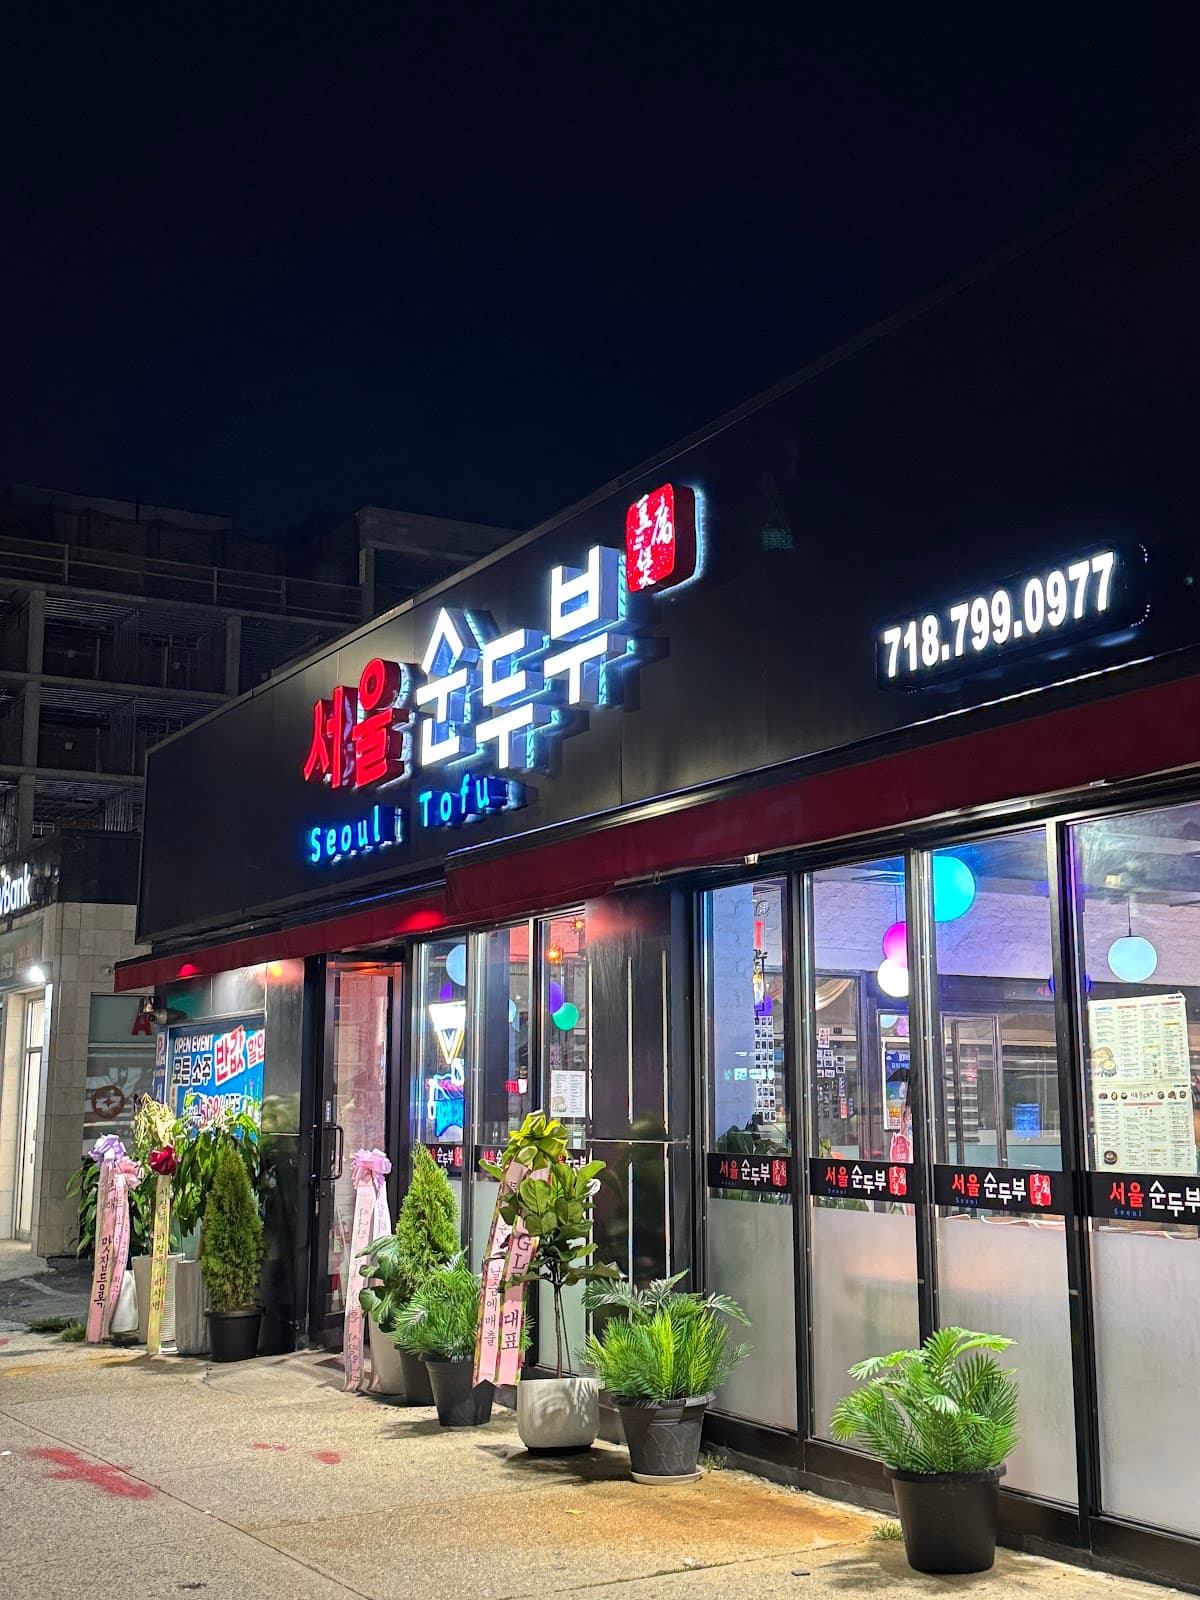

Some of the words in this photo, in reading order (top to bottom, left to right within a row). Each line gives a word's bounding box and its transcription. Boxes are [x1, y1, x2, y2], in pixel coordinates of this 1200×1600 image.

[883, 551, 1116, 679] 718.799.0977
[303, 657, 393, 790] 서울
[416, 545, 609, 769] 순두부
[309, 804, 381, 863] Seoul
[419, 773, 491, 828] Tofu
[173, 1056, 191, 1086] 모든
[191, 1054, 213, 1086] 소주
[215, 1026, 245, 1086] 반값
[174, 1037, 191, 1054] OPEN
[192, 1034, 214, 1053] EVENT
[437, 1147, 454, 1167] 순두부
[720, 1160, 739, 1180] 서울
[741, 1159, 770, 1186] 순두부
[825, 1166, 848, 1188] 서울
[851, 1164, 887, 1195] 순두부
[951, 1173, 981, 1198] 서울
[983, 1170, 1027, 1205] 순두부
[1109, 1181, 1145, 1208] 서울
[955, 1197, 979, 1206] Seoul
[1113, 1208, 1142, 1217] Seoul
[483, 1313, 498, 1348] 매출
[501, 1308, 520, 1350] 대표
